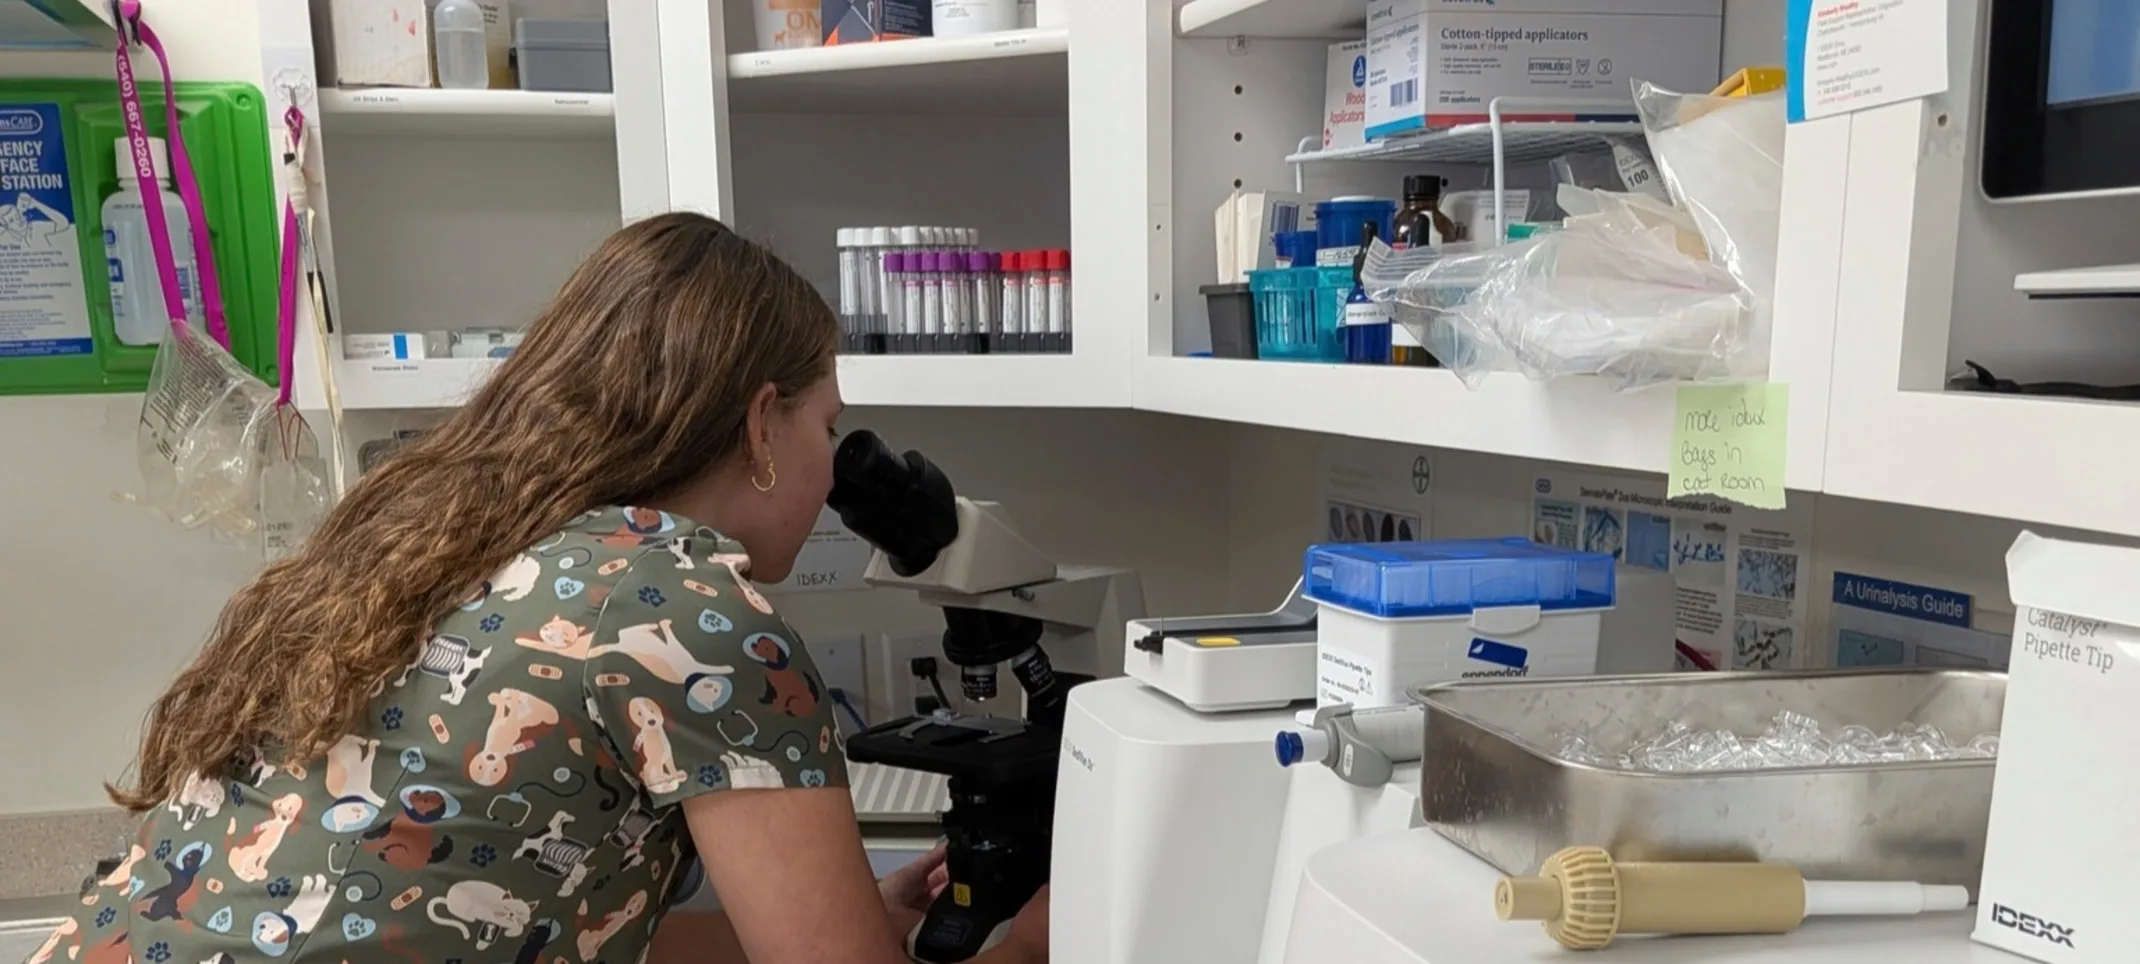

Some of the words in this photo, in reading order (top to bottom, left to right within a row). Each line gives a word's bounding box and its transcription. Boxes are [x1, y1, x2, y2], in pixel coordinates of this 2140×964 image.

[1441, 27, 1522, 43] Cotton-tipped
[1525, 28, 1589, 43] applicators
[118, 55, 133, 97] (540)
[126, 101, 152, 178] 667-0260
[0, 140, 43, 157] ENCY
[2, 157, 39, 173] FACE
[2, 173, 63, 190] STATION
[1627, 169, 1649, 188] 100
[1723, 441, 1742, 465] in
[1683, 471, 1712, 491] cat
[1709, 501, 1732, 515] Guide
[796, 570, 838, 587] IDEXX
[1844, 580, 1854, 597] A
[1856, 581, 1919, 611] Urinalysis
[1922, 594, 1964, 619] Guide
[2024, 631, 2082, 663] Pipette
[2086, 644, 2114, 674] Tip
[1991, 902, 2076, 950] IDEXX
